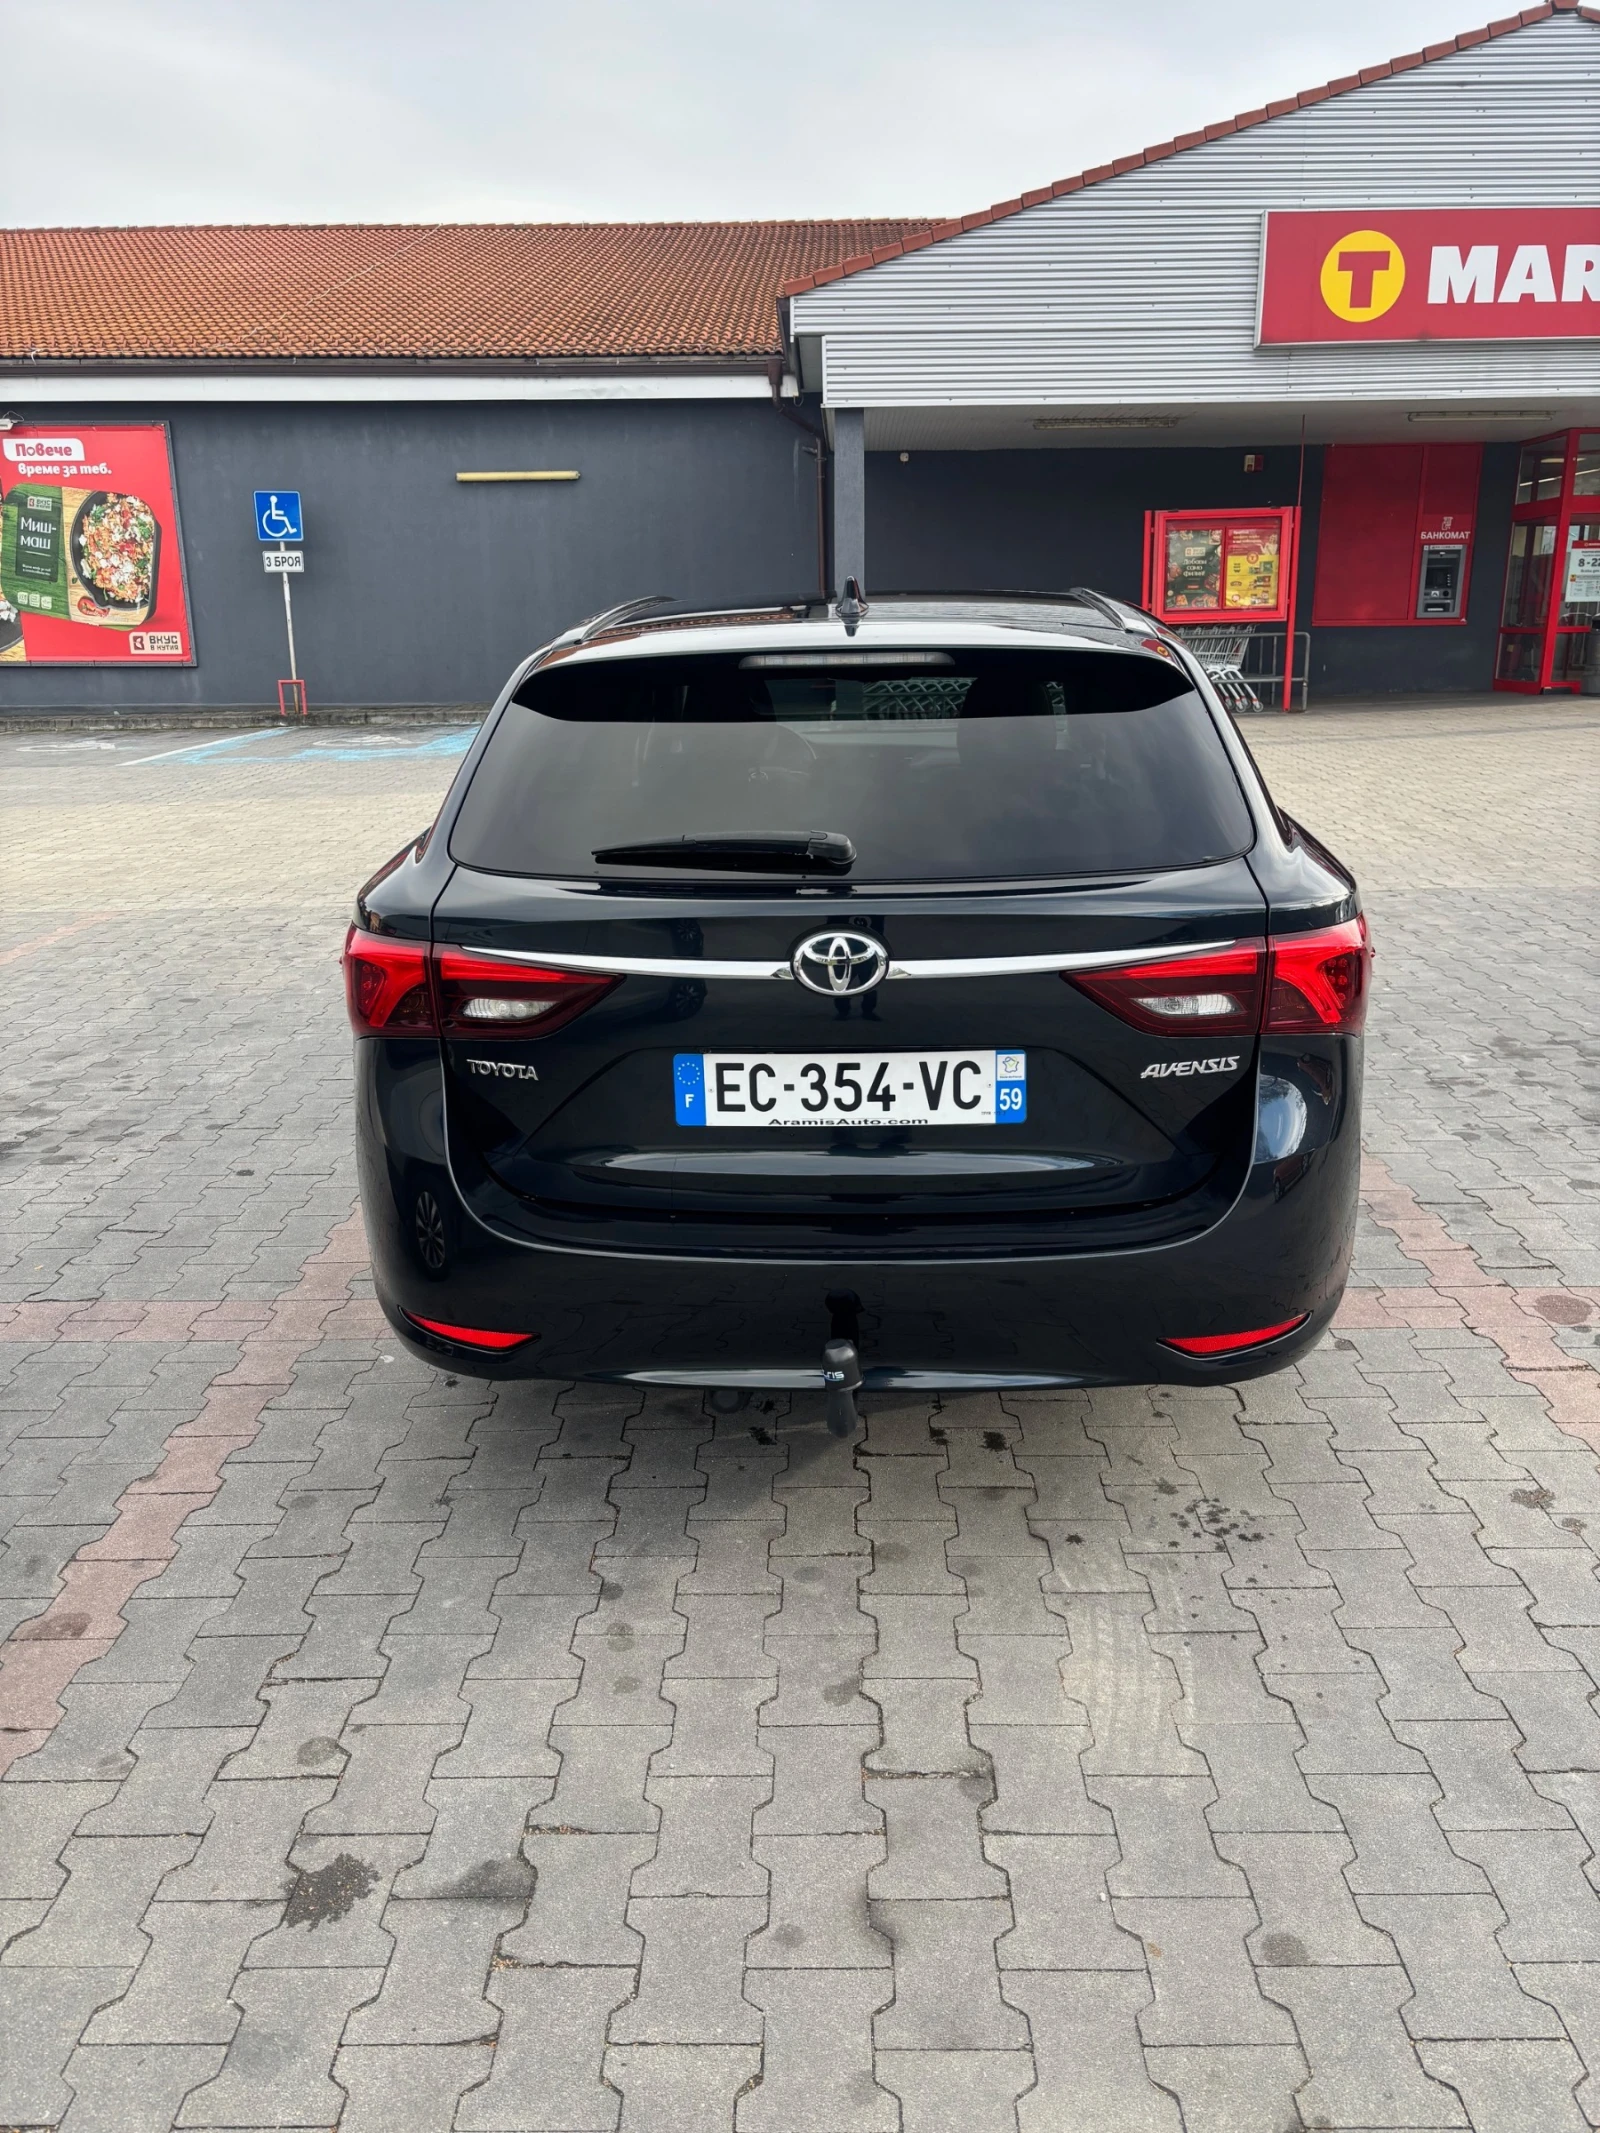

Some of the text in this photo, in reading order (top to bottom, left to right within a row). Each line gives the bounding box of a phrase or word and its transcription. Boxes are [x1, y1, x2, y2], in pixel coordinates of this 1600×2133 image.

[1337, 244, 1600, 309] T MAR
[15, 443, 73, 457] Повече
[18, 462, 113, 478] време за теб.
[20, 516, 57, 534] Миш-
[20, 535, 51, 550] маш
[1420, 531, 1471, 540] БАНКОМАТ
[265, 556, 301, 567] 3 БРОЯ
[149, 635, 178, 644] ВКУС
[466, 1058, 539, 1081] TOYOTA
[1140, 1055, 1241, 1079] AVENSIS
[715, 1060, 982, 1113] EC-354-VC
[684, 1093, 694, 1108] F
[999, 1087, 1023, 1111] 59
[768, 1118, 929, 1126] AramisAuto.com
